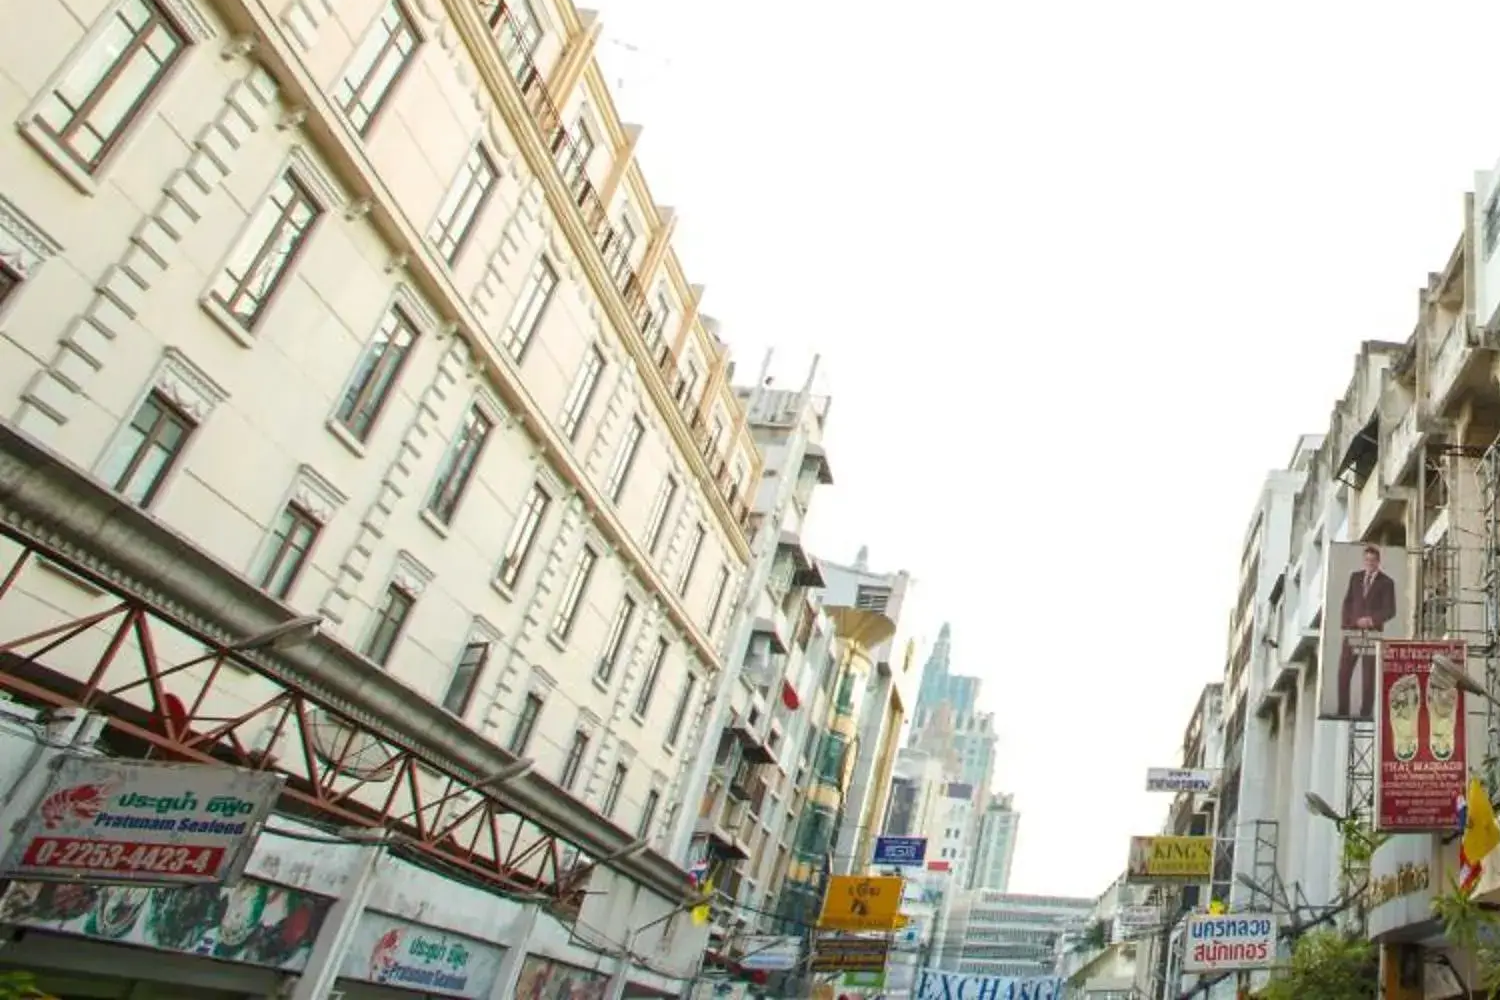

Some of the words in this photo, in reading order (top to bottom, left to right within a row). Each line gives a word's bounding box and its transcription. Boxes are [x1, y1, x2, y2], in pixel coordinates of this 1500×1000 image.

[94, 812, 176, 831] Pratunam
[177, 817, 246, 835] Seafood
[35, 840, 210, 873] 0-2253-4423-4
[1192, 919, 1271, 939] นครหลวง
